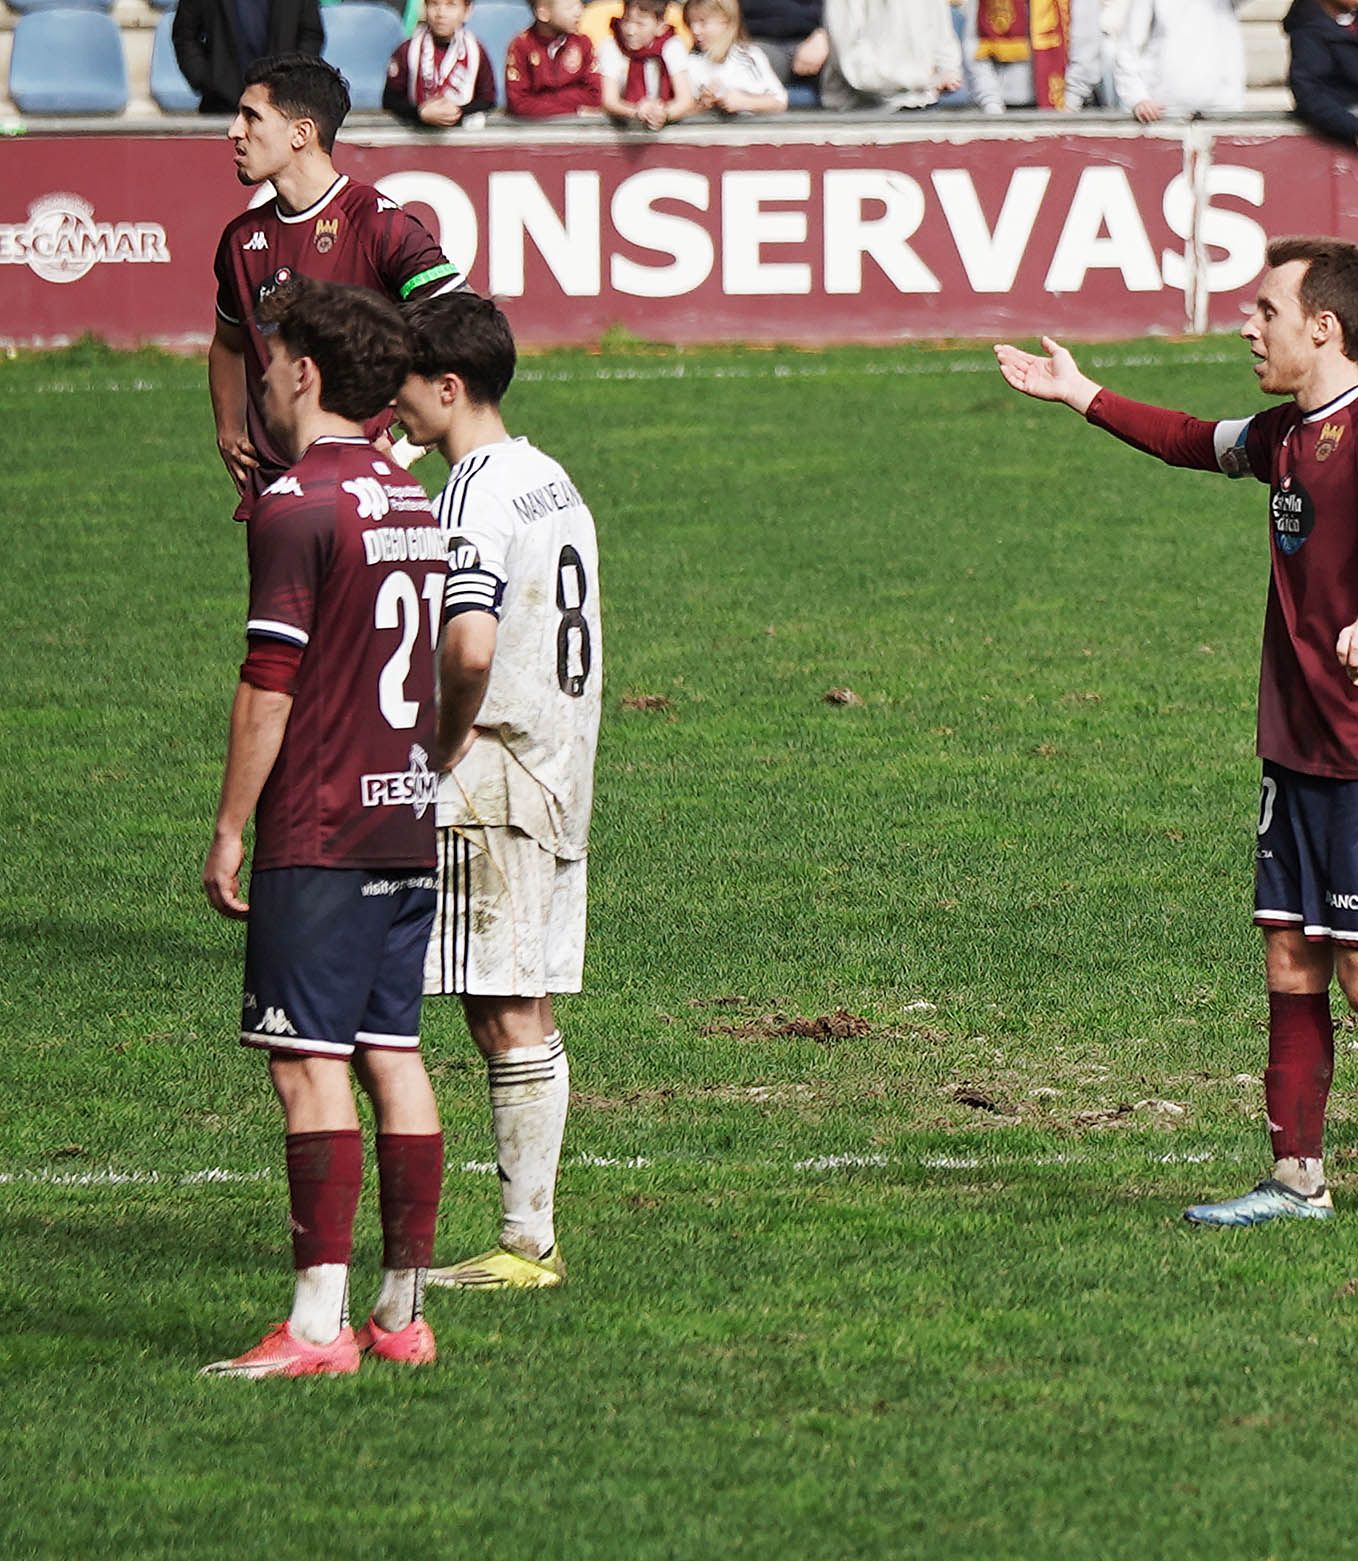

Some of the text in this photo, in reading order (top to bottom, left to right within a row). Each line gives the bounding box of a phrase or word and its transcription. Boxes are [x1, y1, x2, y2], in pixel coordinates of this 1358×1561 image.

[0, 221, 171, 265] ESCAMAR
[248, 166, 1267, 298] ONSERVAS
[556, 544, 591, 698] 8
